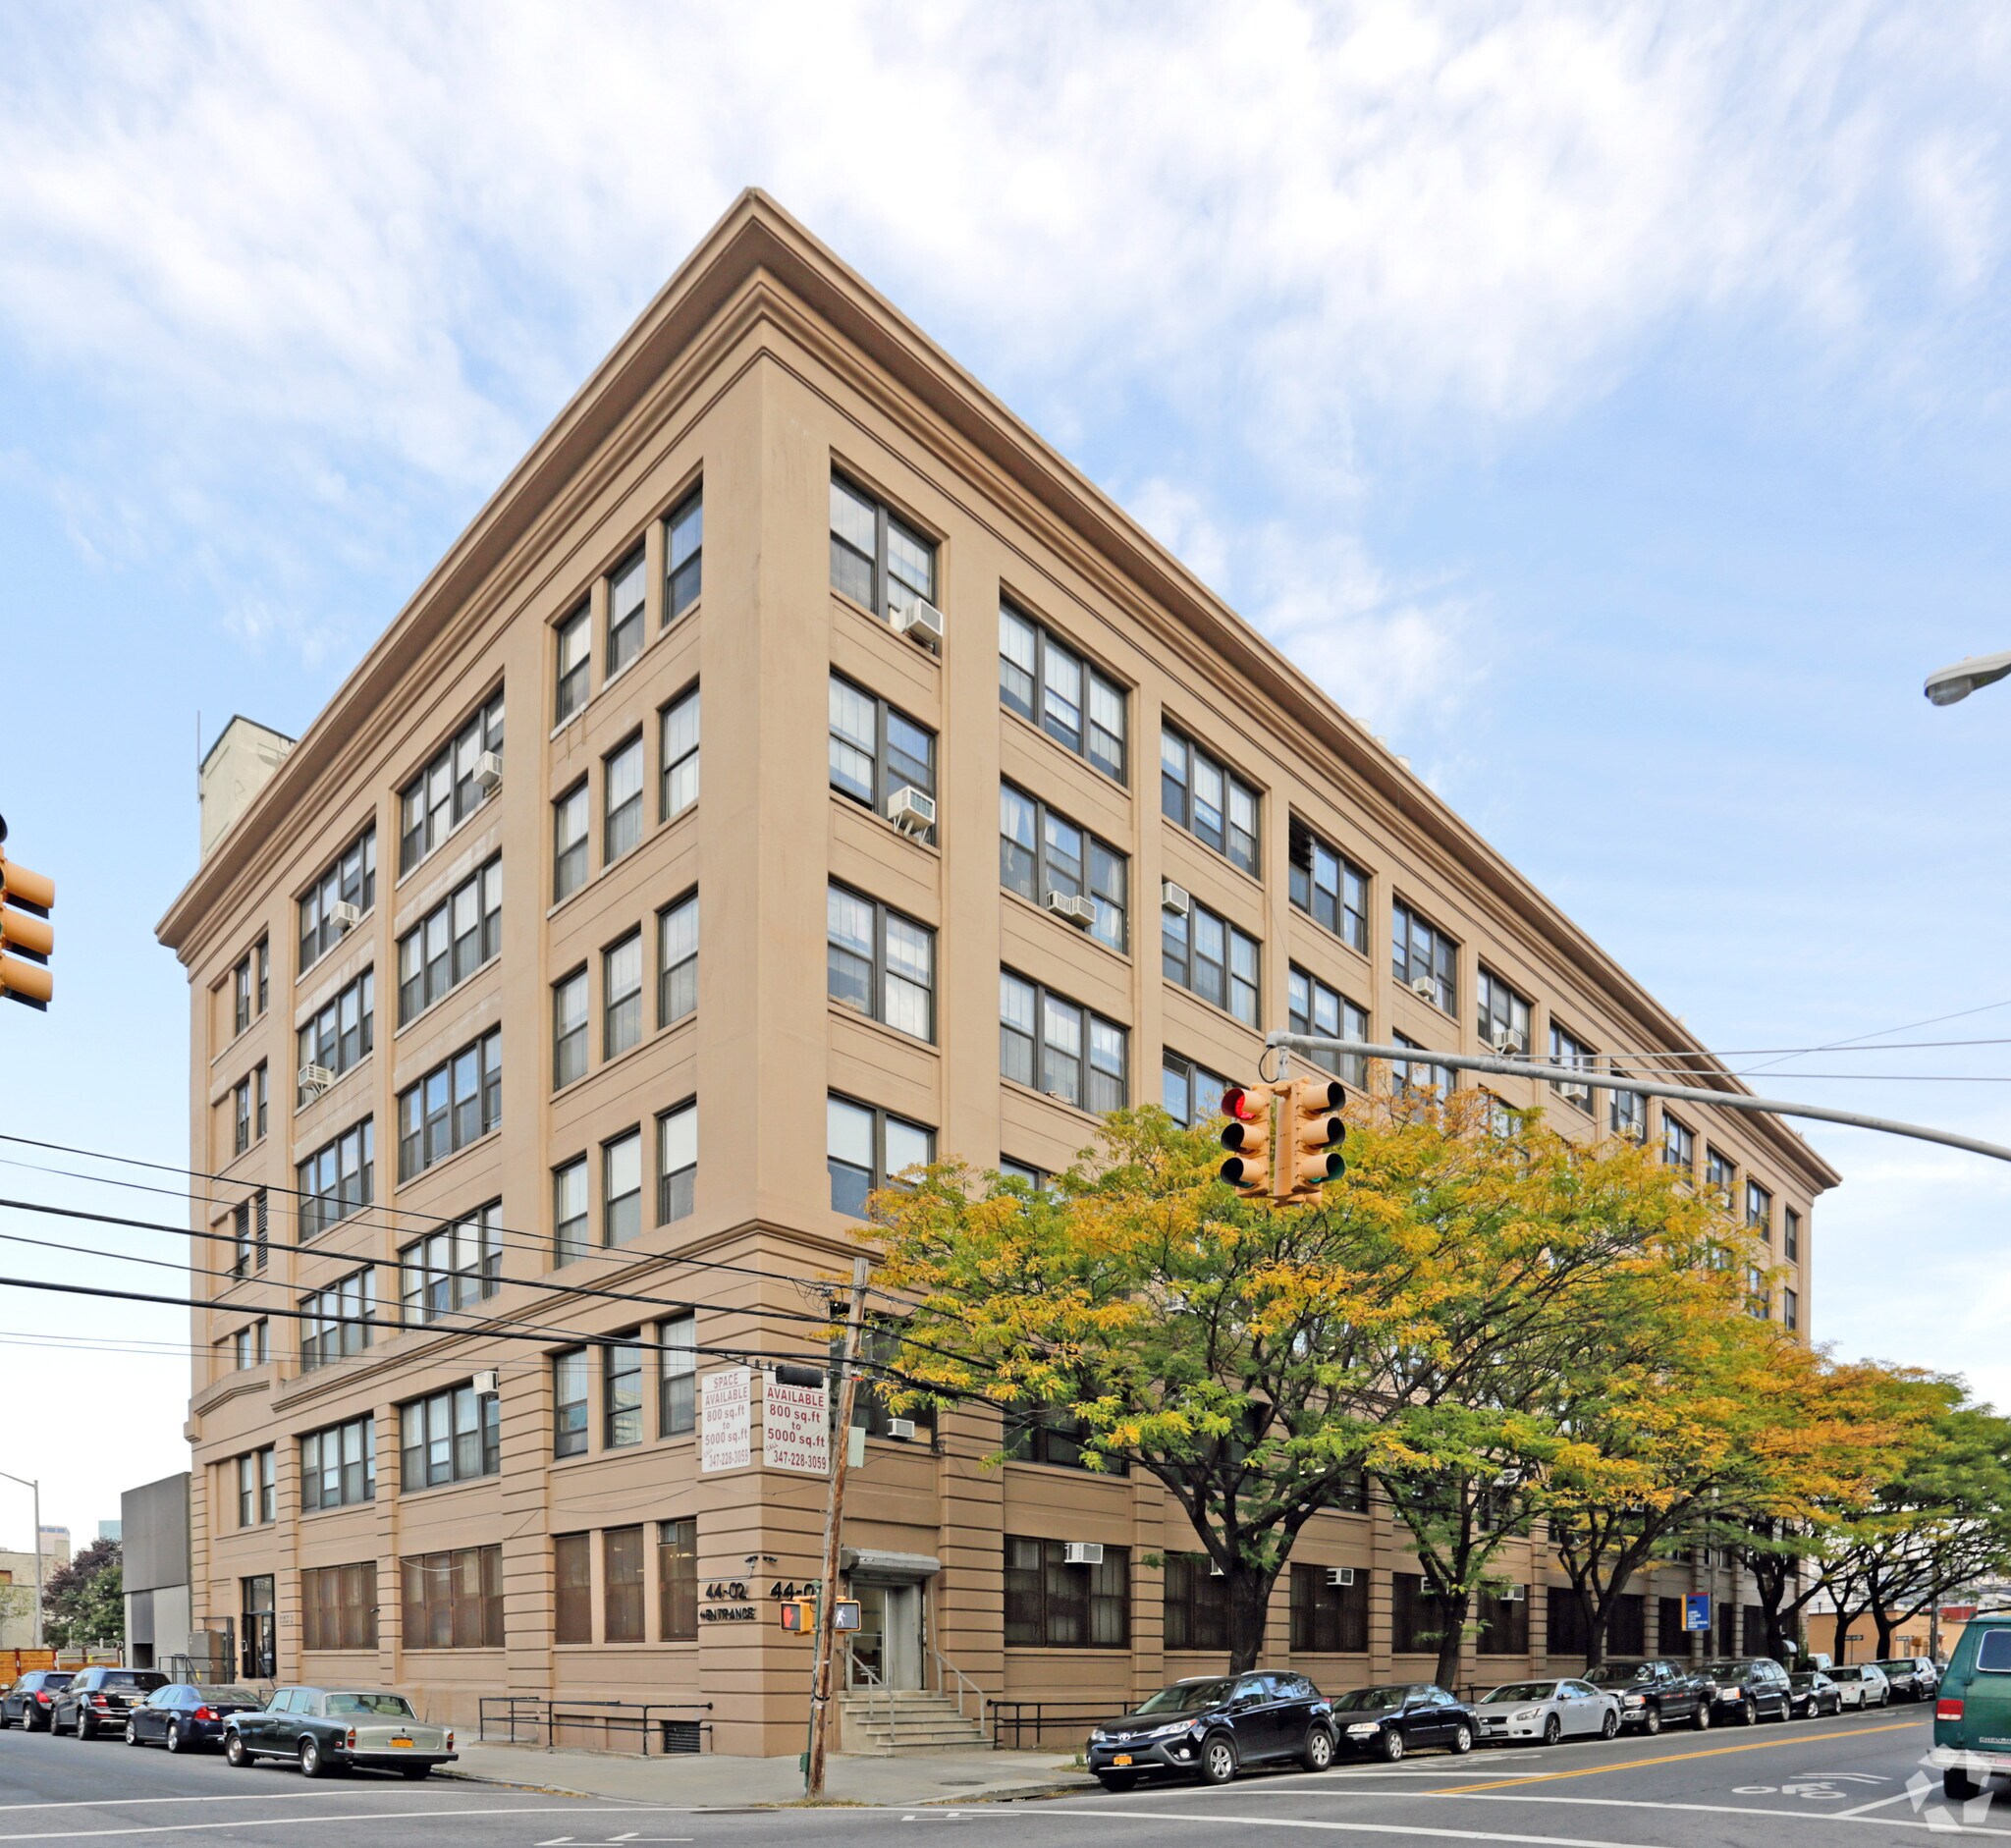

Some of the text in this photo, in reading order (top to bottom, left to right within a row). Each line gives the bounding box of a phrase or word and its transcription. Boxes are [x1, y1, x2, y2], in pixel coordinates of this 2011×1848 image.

[714, 1373, 738, 1389] SPACE
[705, 1386, 748, 1406] AVAILABLE
[767, 1386, 824, 1407] AVAILABLE
[707, 1405, 744, 1422] 800 sq.ft
[770, 1403, 820, 1424] 800 sq.ft
[791, 1421, 801, 1431] to
[705, 1428, 748, 1445] 5000 sq.ft
[768, 1428, 825, 1448] 5000 sq.ft
[766, 1441, 779, 1451] CALL
[774, 1449, 827, 1470] 347-228-3059
[706, 1582, 747, 1600] 44-02
[706, 1606, 756, 1621] ENTRANCE
